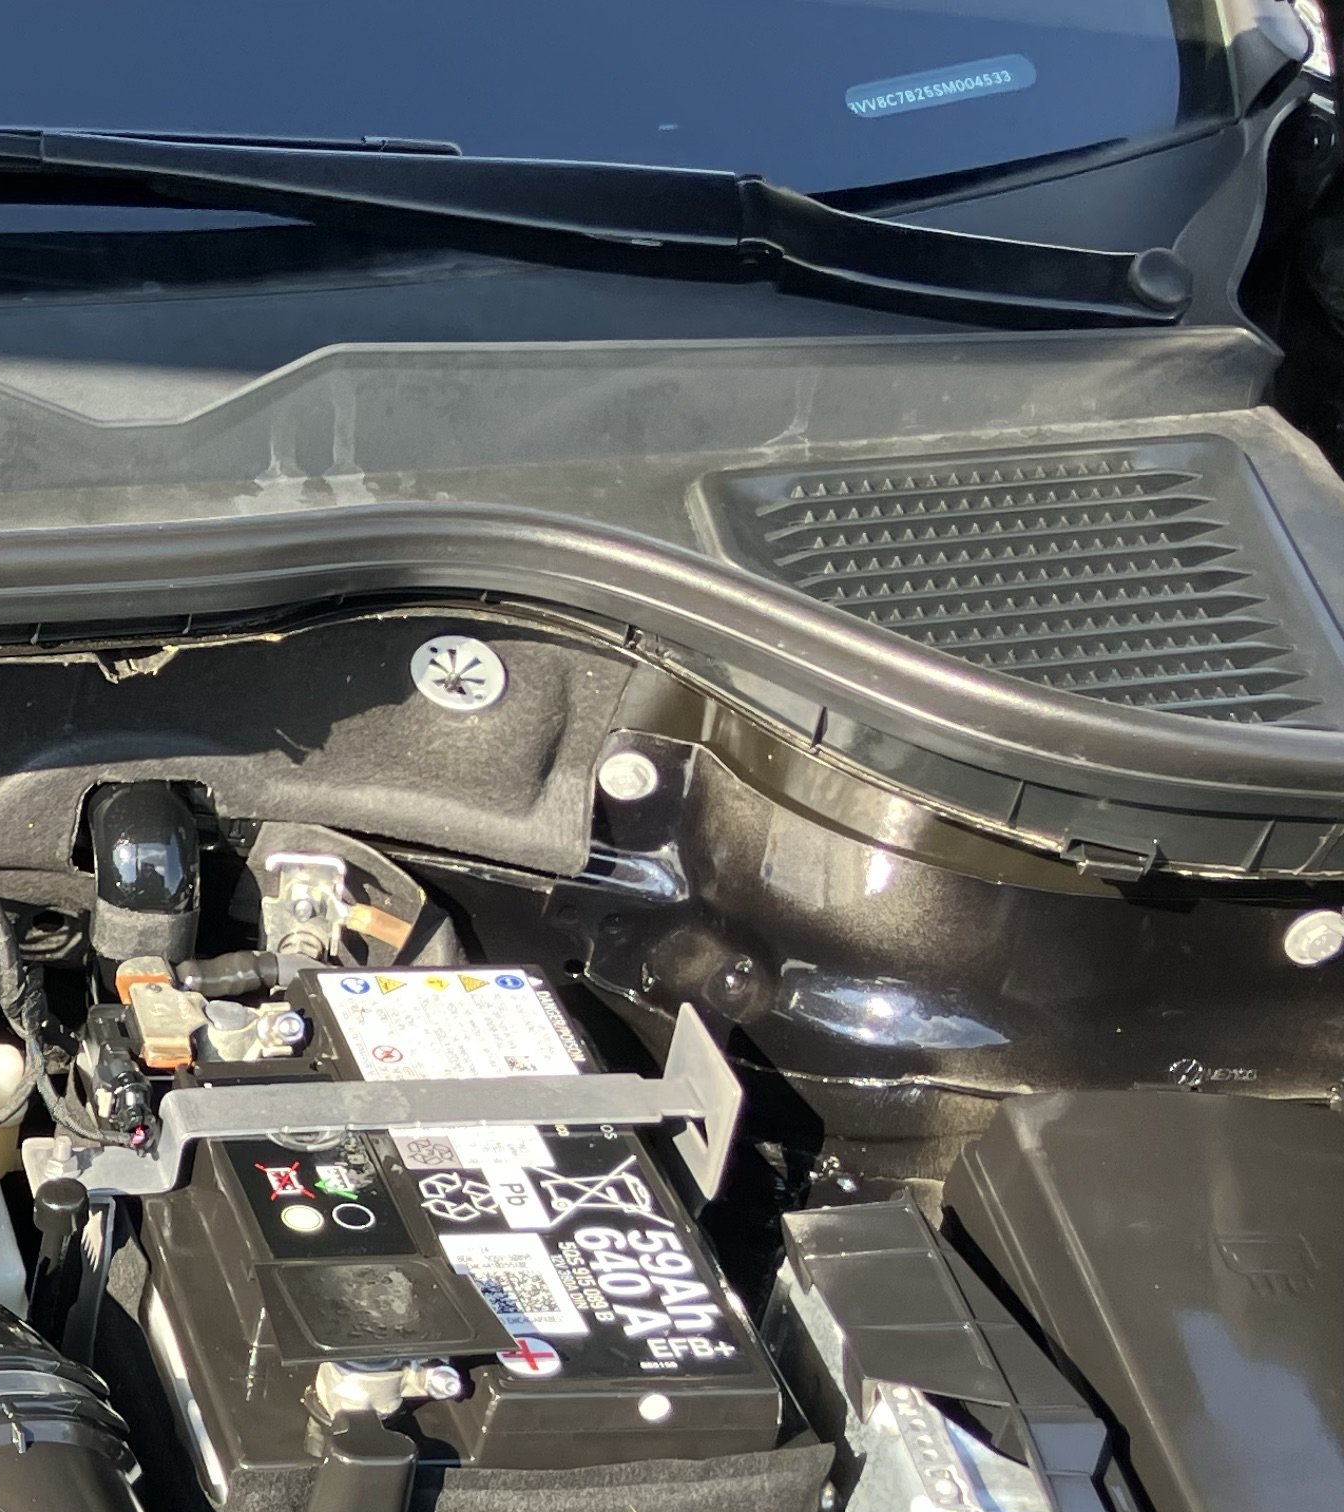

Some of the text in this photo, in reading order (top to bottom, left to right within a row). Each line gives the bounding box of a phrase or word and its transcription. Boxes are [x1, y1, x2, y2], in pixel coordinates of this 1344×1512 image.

[499, 1183, 529, 1206] Pb
[574, 1227, 652, 1297] 640
[627, 1229, 723, 1332] 59Ah
[572, 1267, 597, 1287] 915
[594, 1311, 615, 1321] B
[612, 1304, 672, 1337] A
[646, 1337, 736, 1359] EFB+
